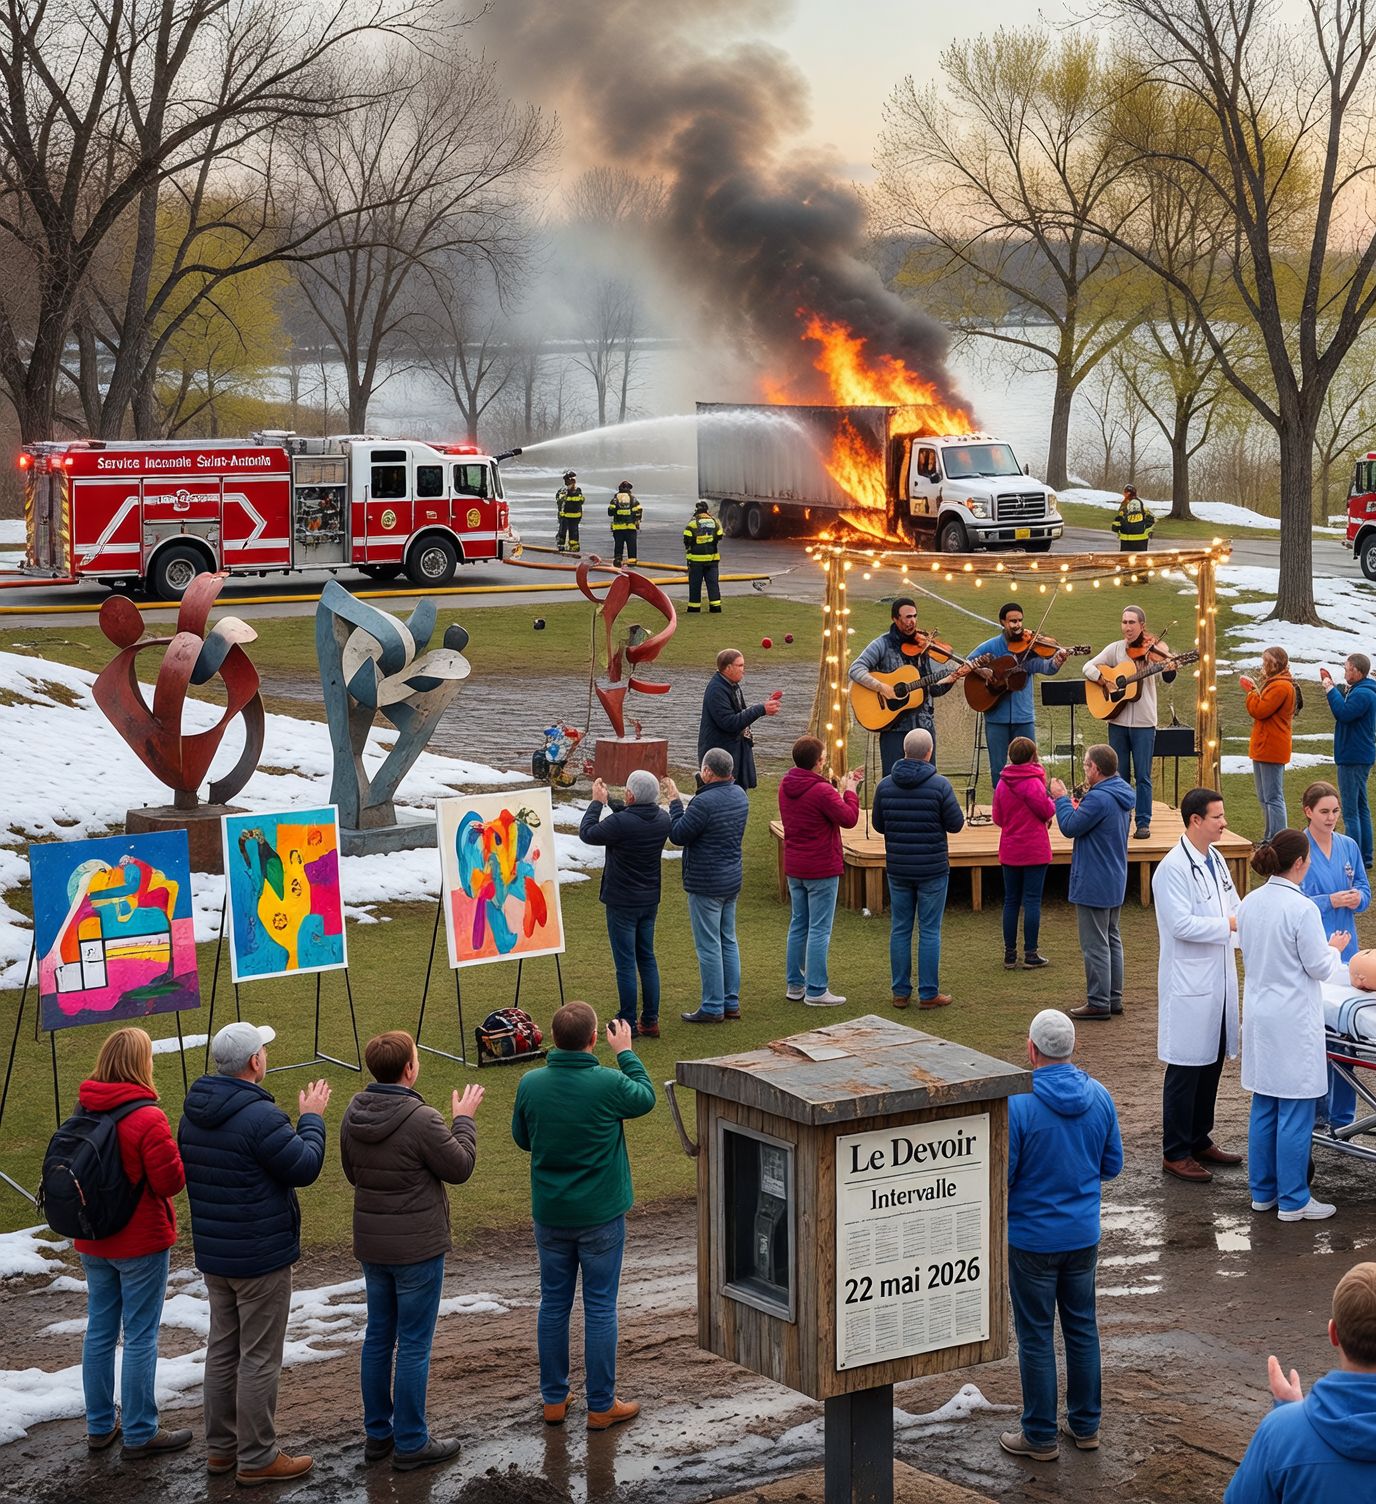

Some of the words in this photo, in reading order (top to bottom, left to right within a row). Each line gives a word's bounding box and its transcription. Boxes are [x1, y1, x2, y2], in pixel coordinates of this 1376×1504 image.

[849, 1144, 886, 1174] Le
[890, 1128, 978, 1167] Devoir
[869, 1178, 957, 1211] Intervalle
[844, 1276, 874, 1305] 22
[879, 1266, 921, 1298] mai
[926, 1255, 981, 1290] 2026
